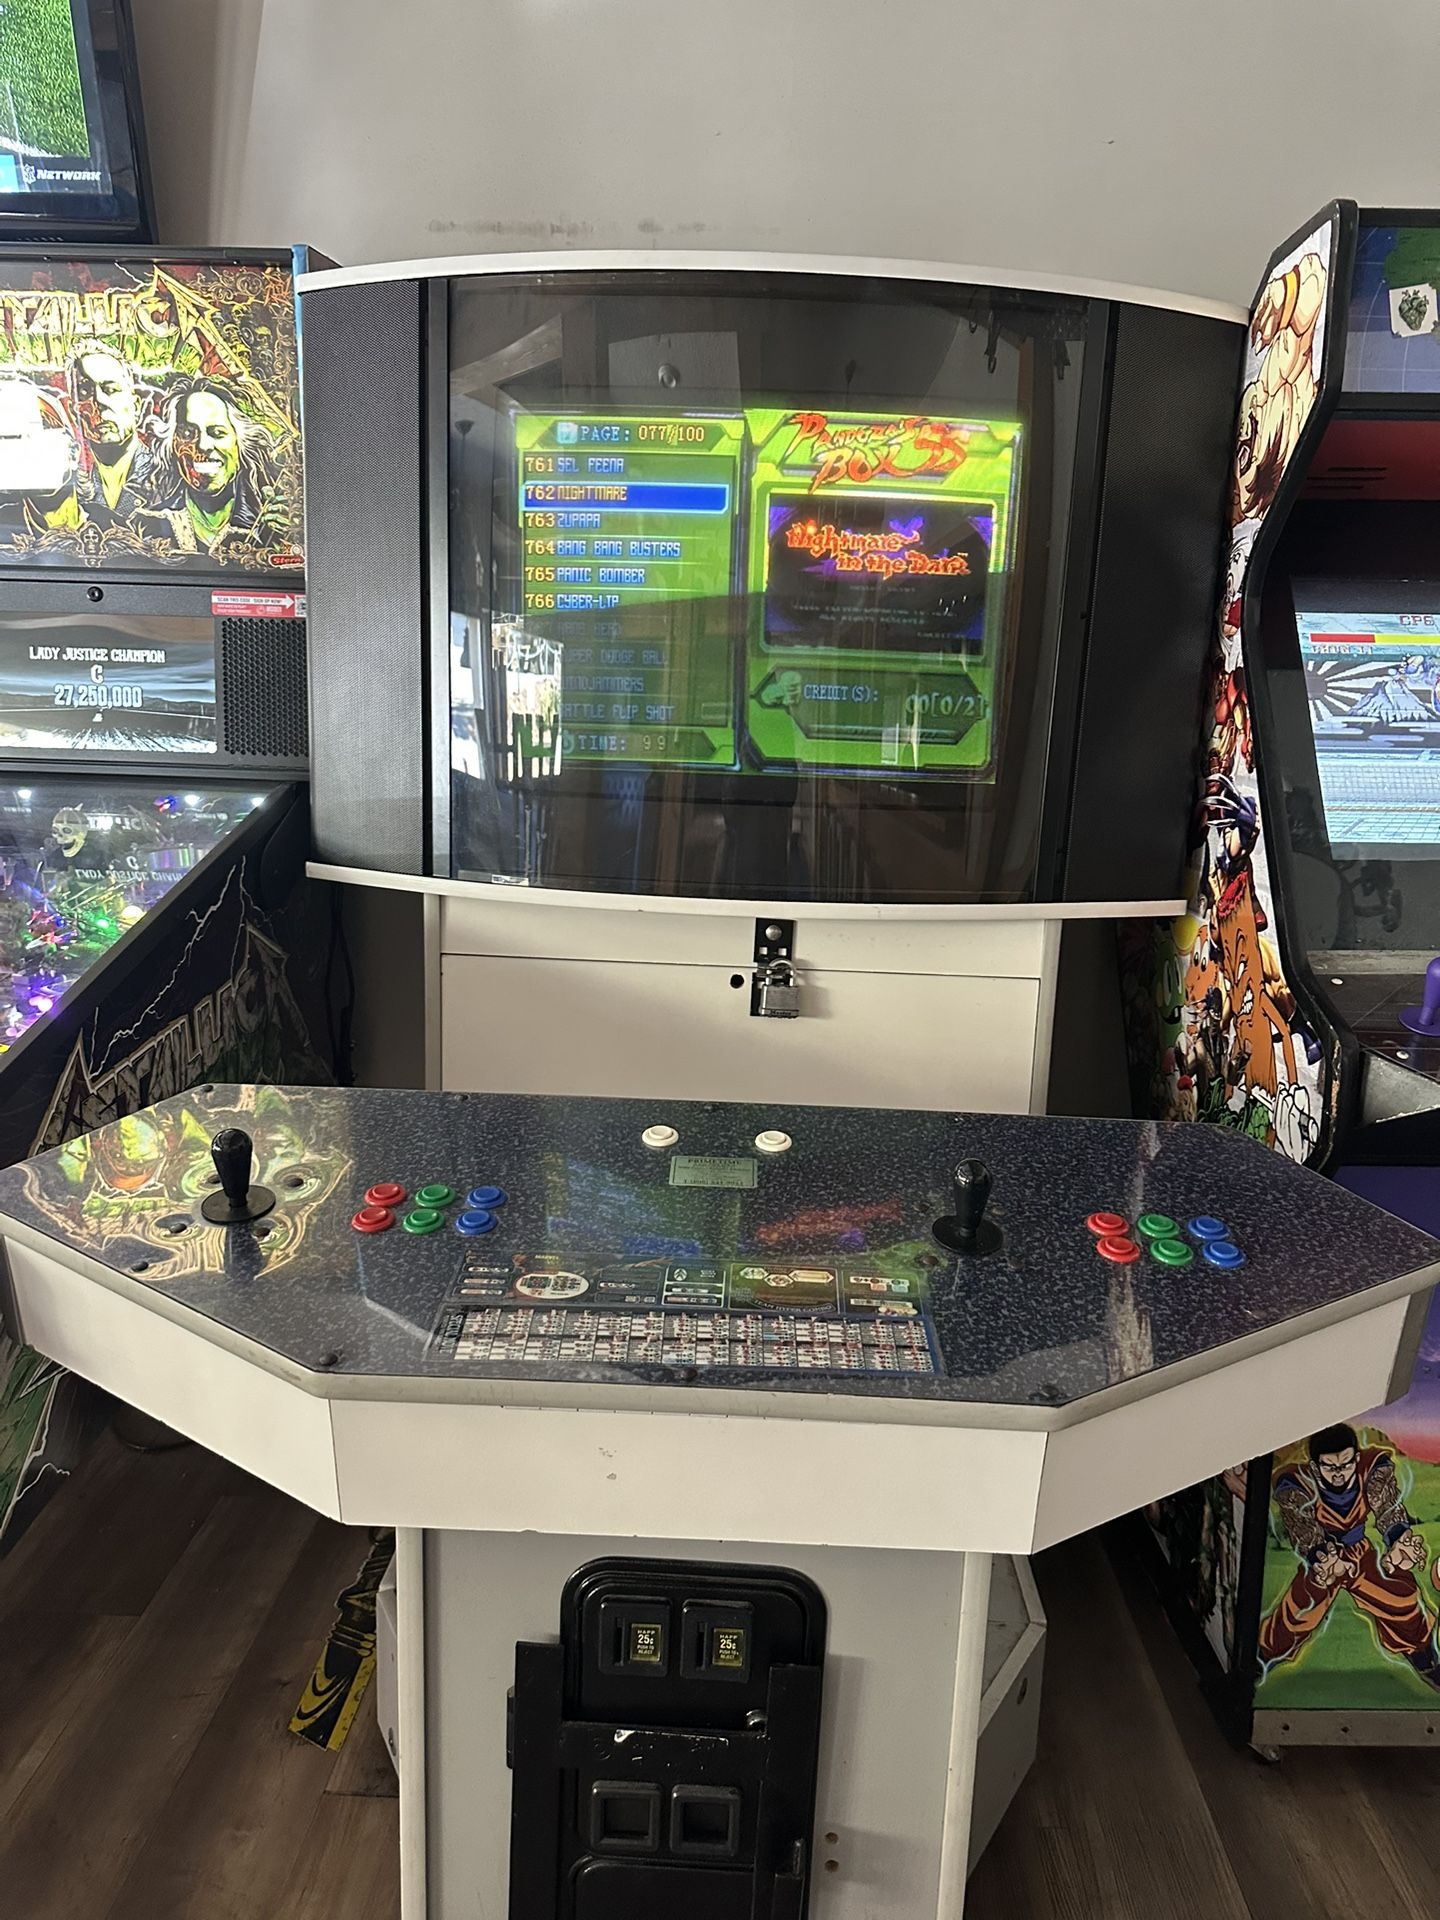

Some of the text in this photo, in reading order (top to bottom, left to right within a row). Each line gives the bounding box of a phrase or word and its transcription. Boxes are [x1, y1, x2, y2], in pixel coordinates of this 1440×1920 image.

[37, 169, 101, 181] NETWORK
[638, 425, 705, 444] 077/100
[525, 457, 625, 473] 761 SEL FEENA
[808, 443, 918, 494] BOX
[526, 485, 628, 501] 762 NIGHTMARE
[525, 513, 601, 528] 763 ZUPAPA
[525, 540, 681, 557] 764 BANG BANG BUSTERS
[786, 522, 922, 558] Nightmare
[836, 552, 863, 571] in
[864, 553, 907, 580] the
[904, 550, 971, 576] Dark
[525, 567, 645, 583] 765 PANIC BOMBER
[525, 594, 620, 609] 766 CYBER-LIP
[29, 646, 166, 663] LADY JUSTICE CHAMPION
[90, 664, 104, 684] C
[53, 684, 144, 709] 27,250,000
